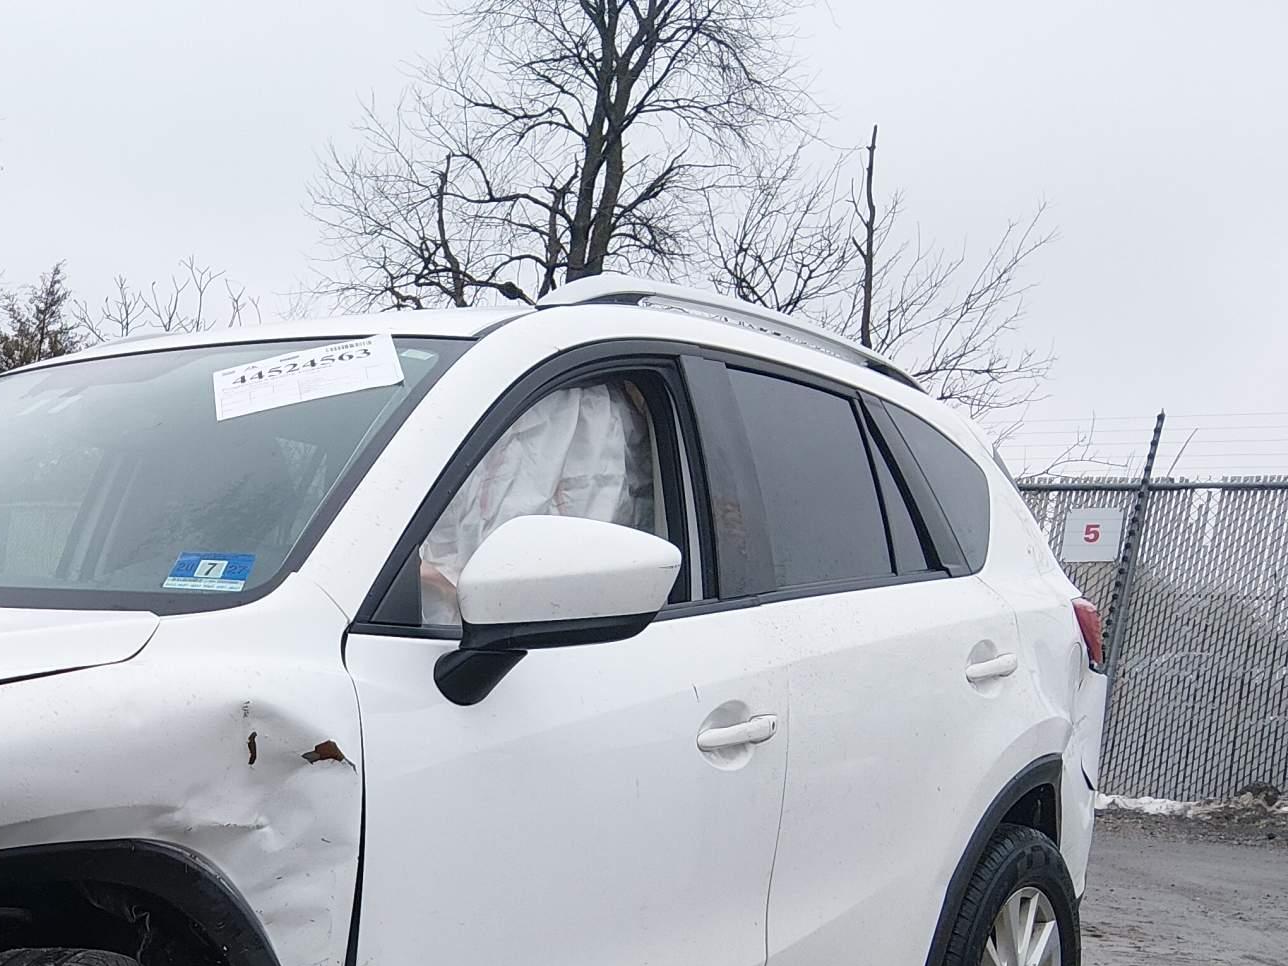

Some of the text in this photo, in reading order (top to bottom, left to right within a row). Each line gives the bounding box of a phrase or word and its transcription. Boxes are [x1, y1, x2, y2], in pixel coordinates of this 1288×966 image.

[232, 348, 372, 384] 44524563
[1083, 524, 1101, 543] 5
[204, 562, 218, 576] 7
